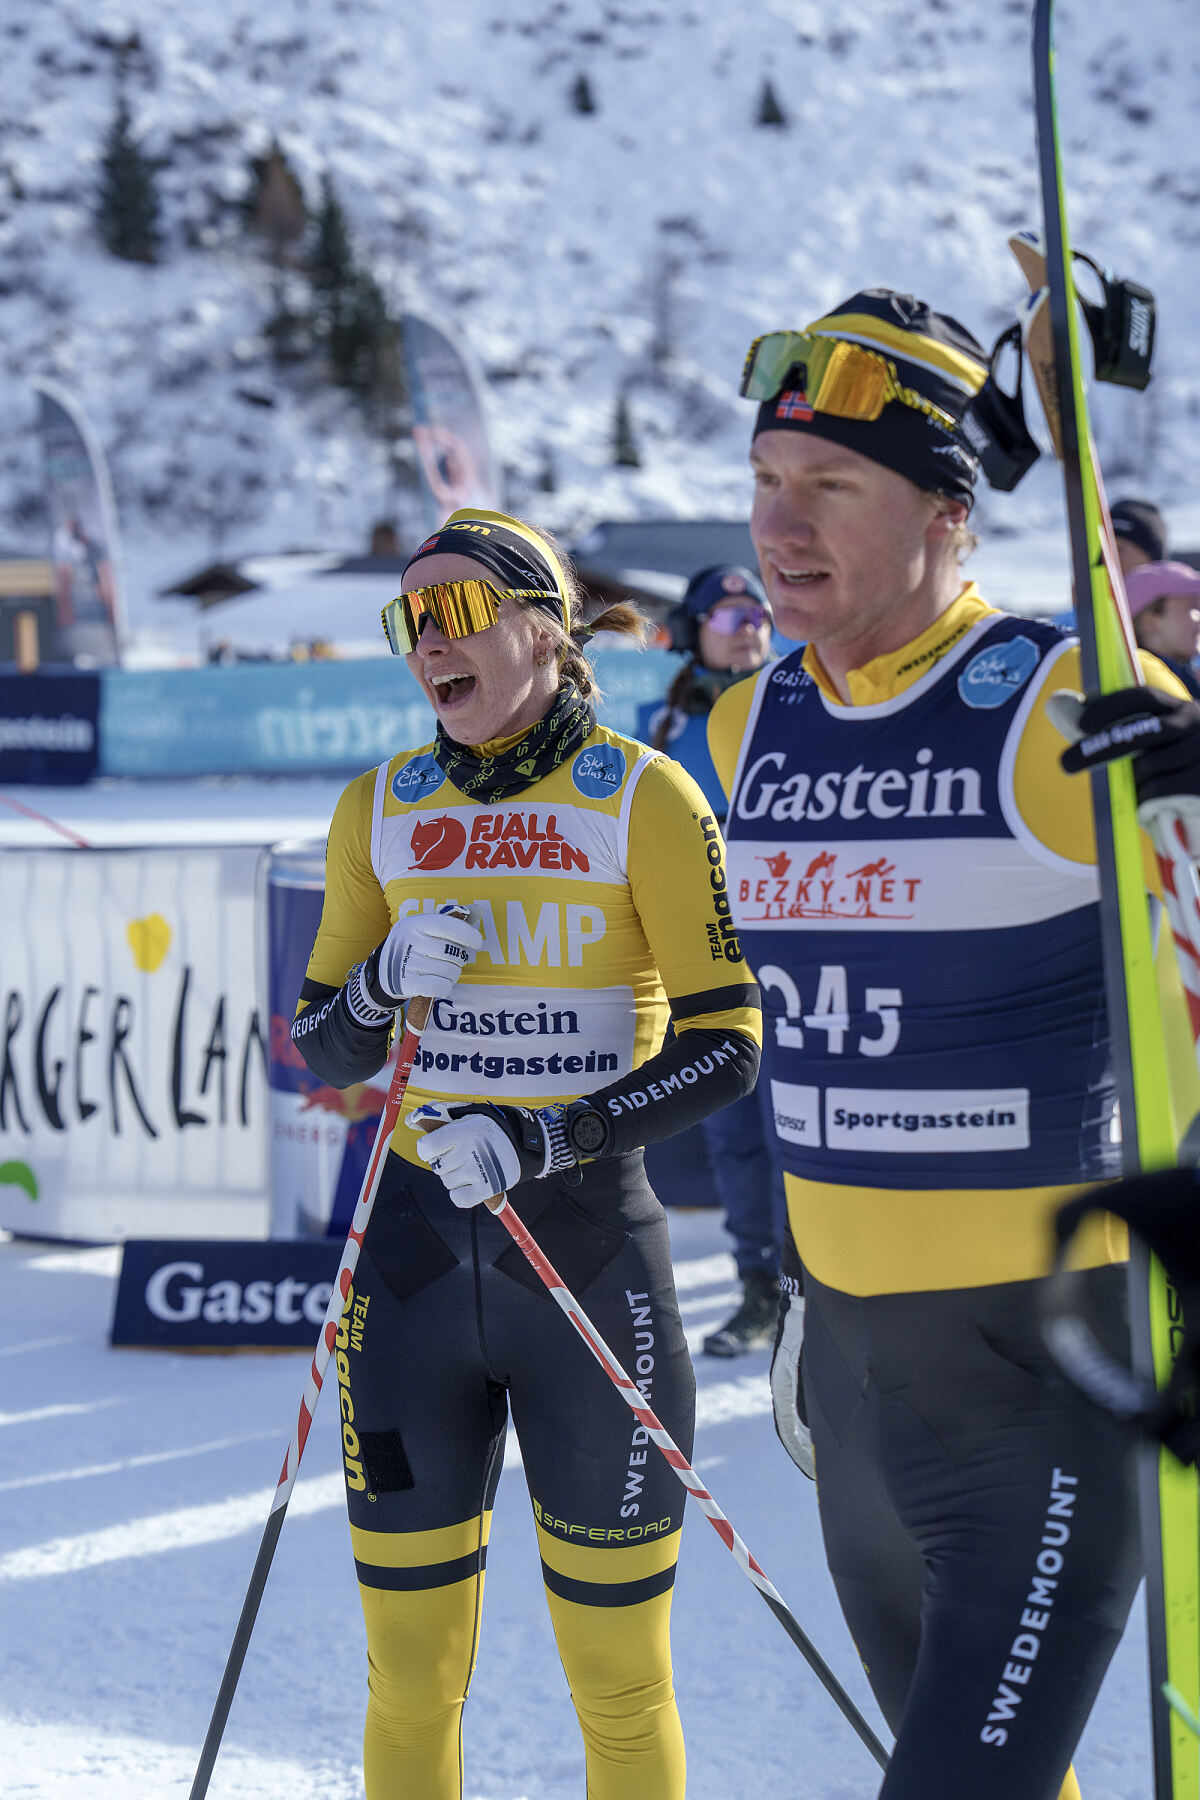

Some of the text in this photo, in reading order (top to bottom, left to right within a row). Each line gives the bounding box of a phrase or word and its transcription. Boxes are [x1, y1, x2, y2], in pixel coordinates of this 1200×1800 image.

[736, 748, 987, 822] Gastein
[470, 812, 564, 842] FJÄLL
[465, 840, 590, 873] RÄVEN
[739, 878, 923, 903] BEZKY.NET
[398, 898, 607, 967] AMP
[708, 923, 723, 961] TEAM
[432, 998, 581, 1036] Gastein
[757, 965, 903, 1057] 245
[412, 1045, 618, 1079] Sportgastein
[833, 1107, 1016, 1132] Sportgastein
[350, 1294, 371, 1352] TEAM
[620, 1289, 655, 1518] SWEDMOUNT
[543, 1514, 672, 1542] SAFEROAD
[980, 1466, 1079, 1747] SWEDEMOUNT
